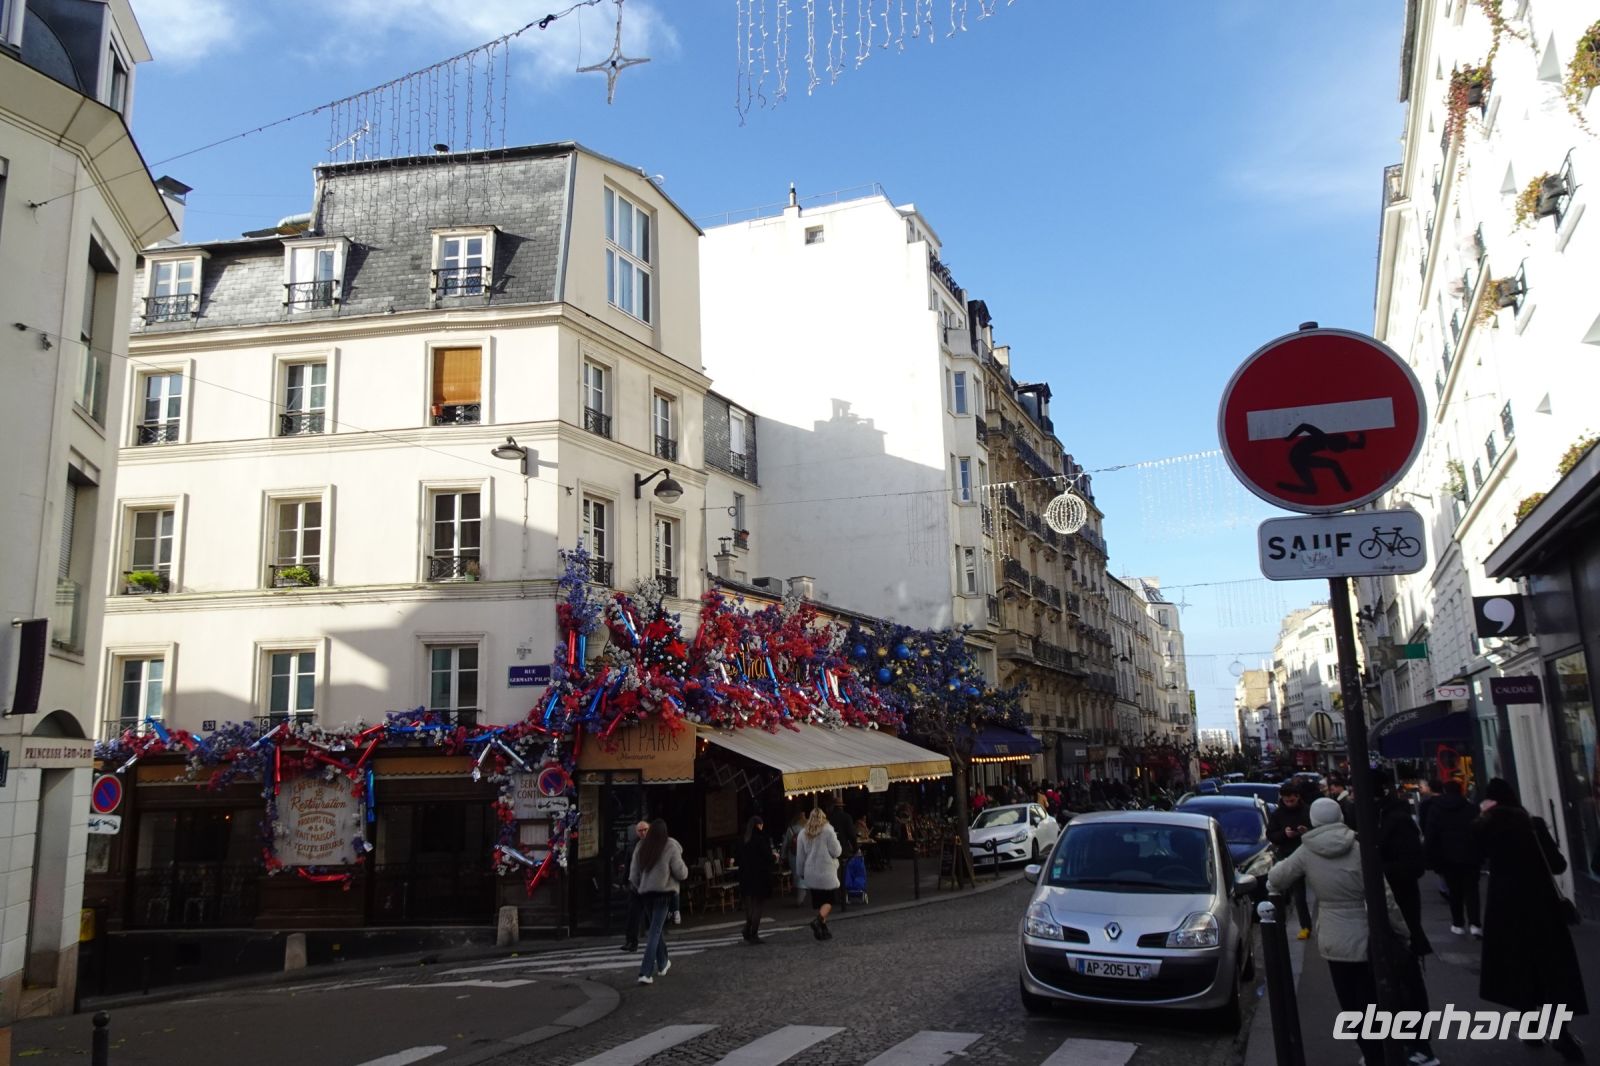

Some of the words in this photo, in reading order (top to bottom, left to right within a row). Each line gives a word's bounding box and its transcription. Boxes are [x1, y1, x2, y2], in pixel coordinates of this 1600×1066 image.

[1268, 532, 1352, 560] SAUF
[638, 721, 680, 753] PARIS
[25, 747, 62, 759] PRINCESSE
[291, 796, 346, 812] Restauration
[297, 815, 321, 826] PRODUITS
[296, 829, 310, 840] FAIT
[311, 830, 337, 841] MAISON
[294, 842, 318, 852] TOUTE
[319, 839, 344, 851] HEURE
[1086, 961, 1142, 977] AP-205-LX
